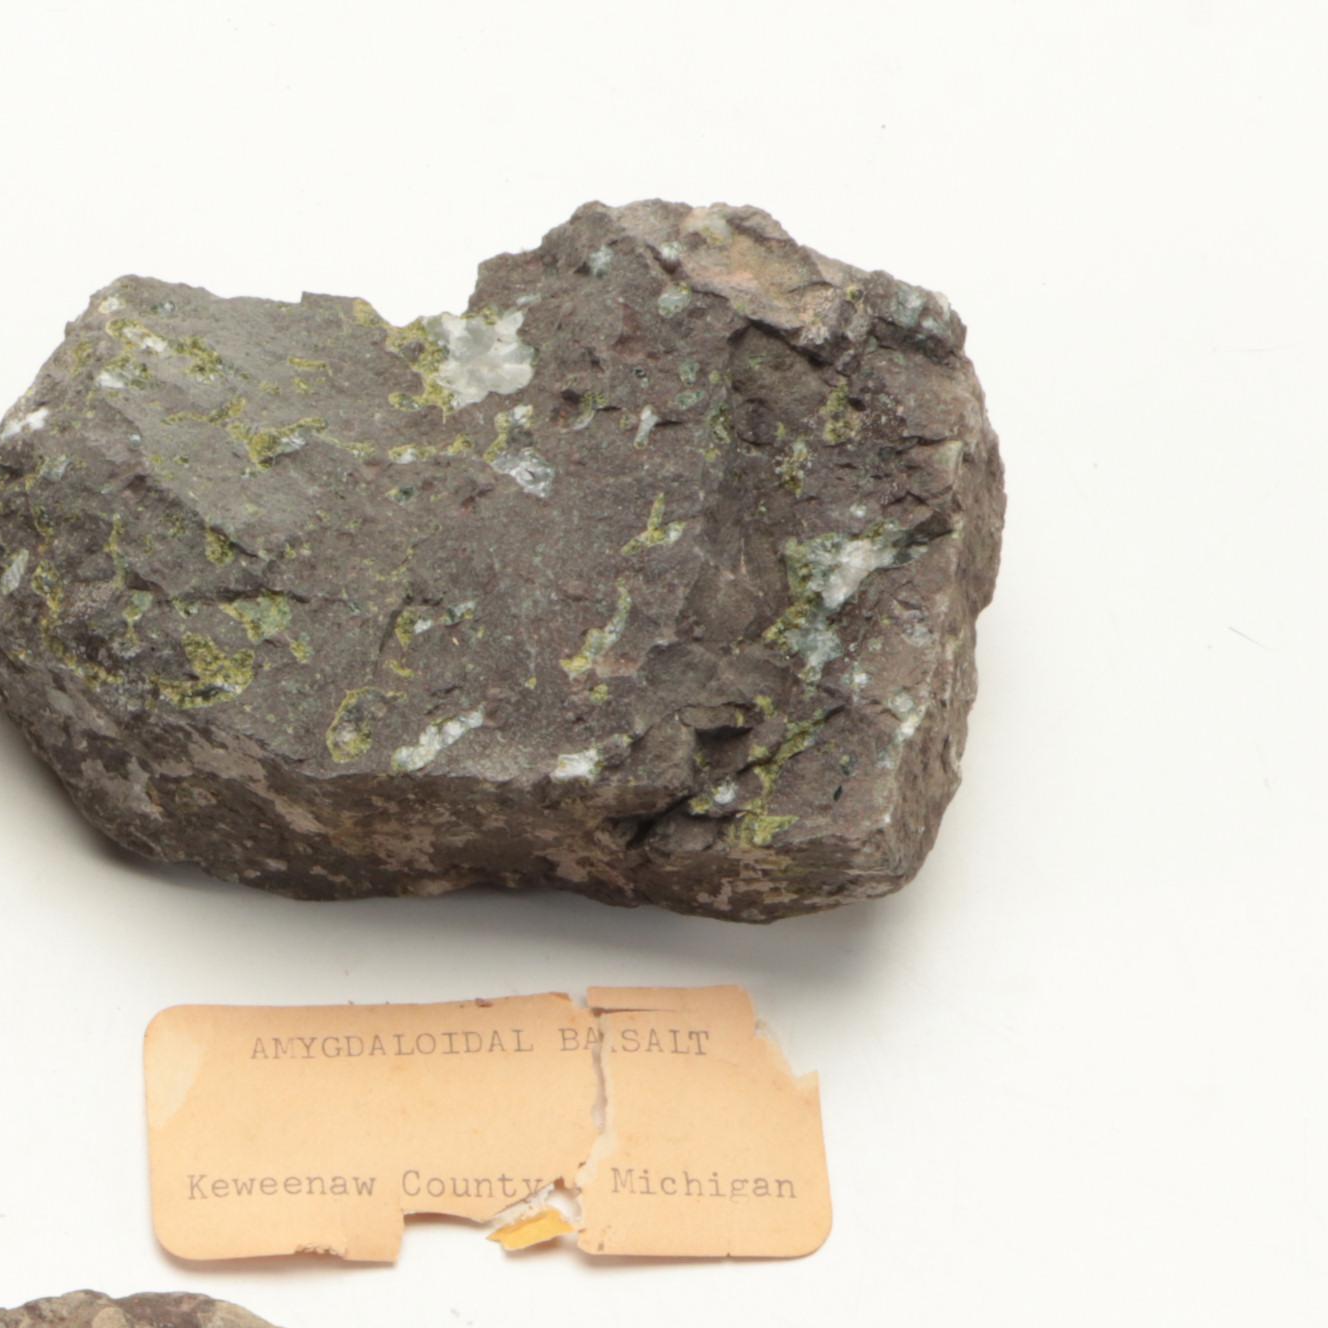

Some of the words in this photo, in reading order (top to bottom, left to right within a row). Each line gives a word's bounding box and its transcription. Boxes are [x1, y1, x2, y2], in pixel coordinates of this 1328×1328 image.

[250, 1029, 534, 1060] AMYGDALOIDAL
[559, 1026, 710, 1056] BASALT
[187, 1174, 377, 1201] Keweenaw
[610, 1167, 797, 1199] Michigan
